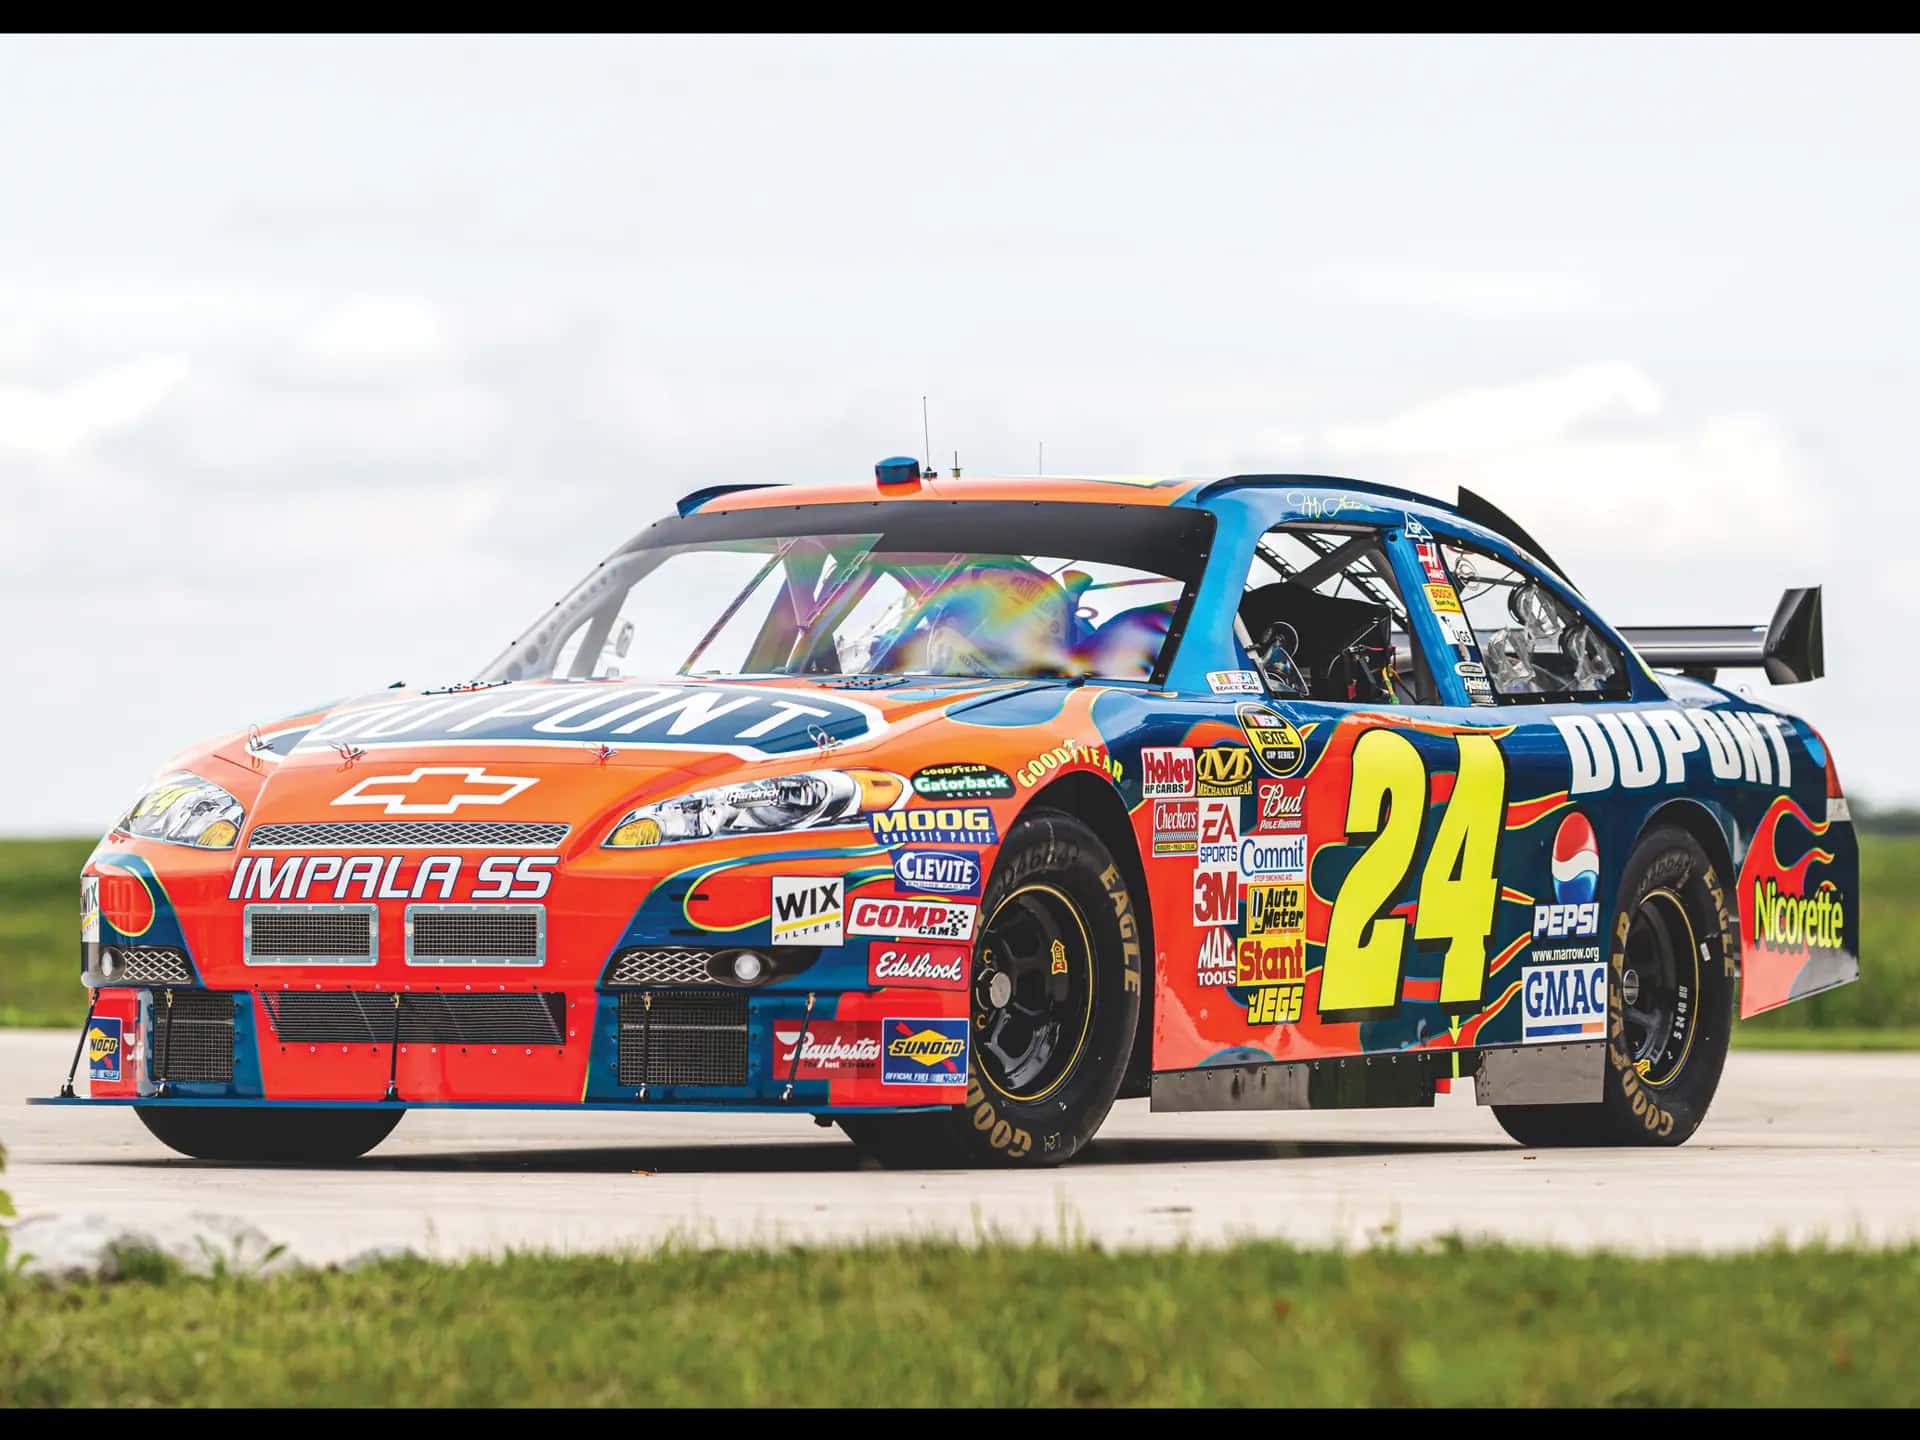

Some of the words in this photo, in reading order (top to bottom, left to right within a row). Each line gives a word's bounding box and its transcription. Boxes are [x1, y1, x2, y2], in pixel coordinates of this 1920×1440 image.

[1256, 730, 1294, 745] NEXTEL
[1551, 708, 1795, 795] DUPONT
[921, 764, 987, 778] GOODYEAR
[1016, 738, 1124, 788] GOODYEAR
[1143, 751, 1194, 793] Holley
[912, 774, 1009, 793] Gatorback
[1144, 784, 1156, 794] HP
[1156, 783, 1184, 794] CARBS
[1258, 783, 1306, 818] Bud
[872, 807, 991, 833] MOOG
[1156, 804, 1197, 831] Checkers
[1201, 802, 1238, 844] EA
[882, 831, 943, 843] CHASSIS
[950, 831, 992, 843] PARTS
[899, 851, 973, 883] CLEVITE
[1199, 845, 1238, 863] SPORTS
[1240, 836, 1304, 877] Commit
[229, 857, 463, 900] IMPALA
[472, 857, 560, 900] SS
[1319, 728, 1507, 1021] 24
[775, 883, 840, 922] WIX
[1194, 871, 1238, 923] 3M
[1265, 888, 1298, 908] Auto
[1754, 878, 1843, 948] Nicorette
[773, 920, 841, 942] FILTERS
[856, 903, 948, 929] COMP
[919, 925, 959, 937] CAMS
[1100, 863, 1140, 997] EAGLE
[1263, 909, 1304, 929] Meter
[1533, 902, 1600, 939] PEPSI
[1197, 926, 1237, 969] MAC
[1239, 938, 1304, 981] Stant
[1531, 946, 1600, 962] www.marrow.org
[875, 951, 962, 982] Edelbrock
[1197, 969, 1237, 986] TOOLS
[1248, 985, 1304, 1025] JEGS
[1525, 967, 1605, 1018] GMAC
[776, 1031, 881, 1068] Raybestos
[891, 1040, 964, 1056] SUNOCO
